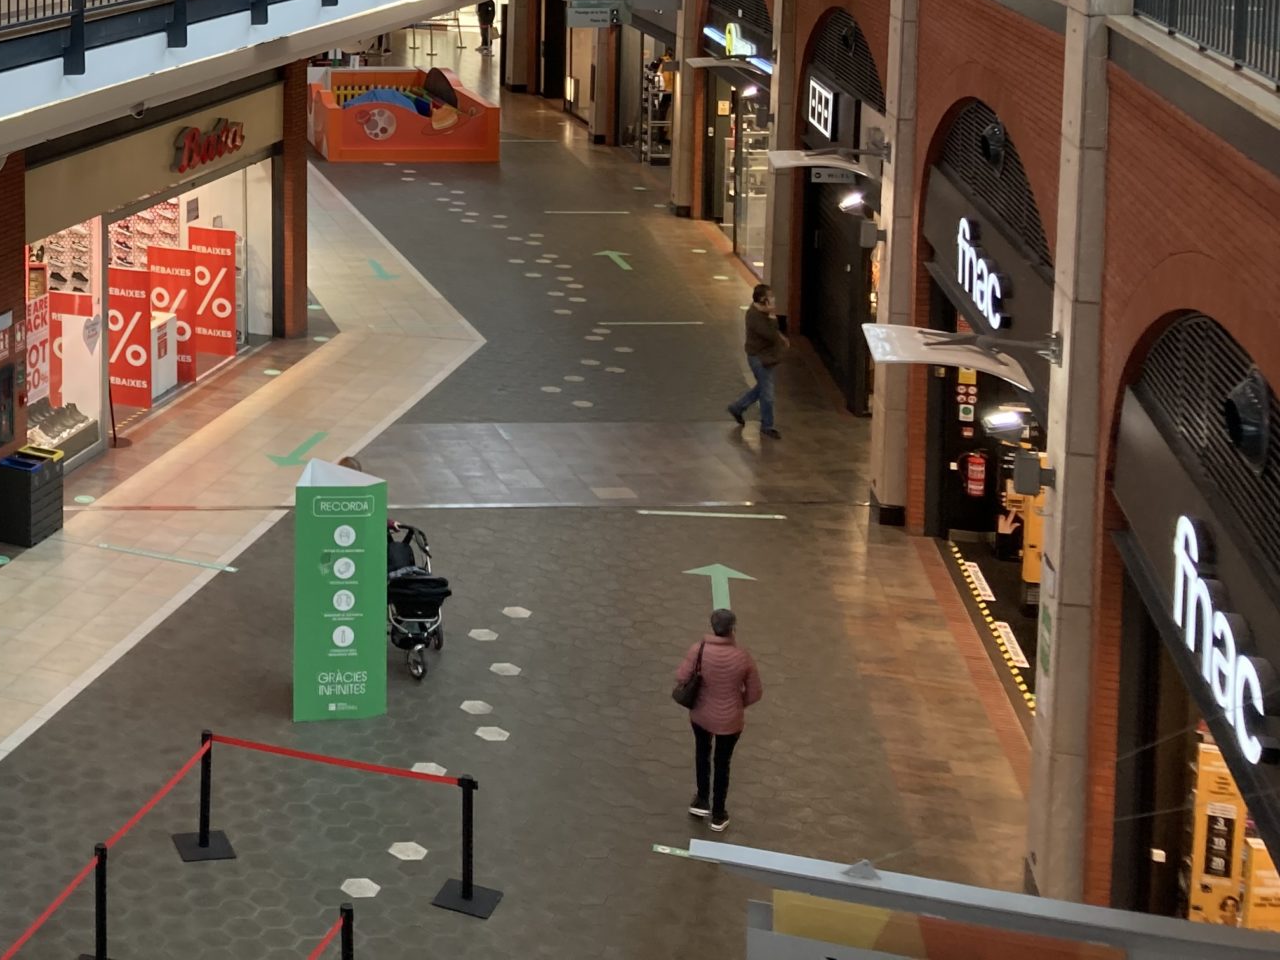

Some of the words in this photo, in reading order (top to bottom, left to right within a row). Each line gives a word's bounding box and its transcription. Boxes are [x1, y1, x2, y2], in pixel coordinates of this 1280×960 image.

[191, 244, 232, 256] REBAIXES
[150, 264, 192, 277] REBAIXES
[958, 217, 1001, 330] fnac
[108, 287, 147, 299] EBAIXES
[26, 312, 48, 333] ACK
[195, 327, 233, 338] EBAIXES
[28, 338, 48, 369] OT
[110, 376, 148, 388] EBAIXES
[320, 501, 369, 512] RECORDA
[1173, 515, 1265, 765] fnac
[318, 669, 368, 683] GRÀCIES
[318, 683, 367, 696] INFINITES
